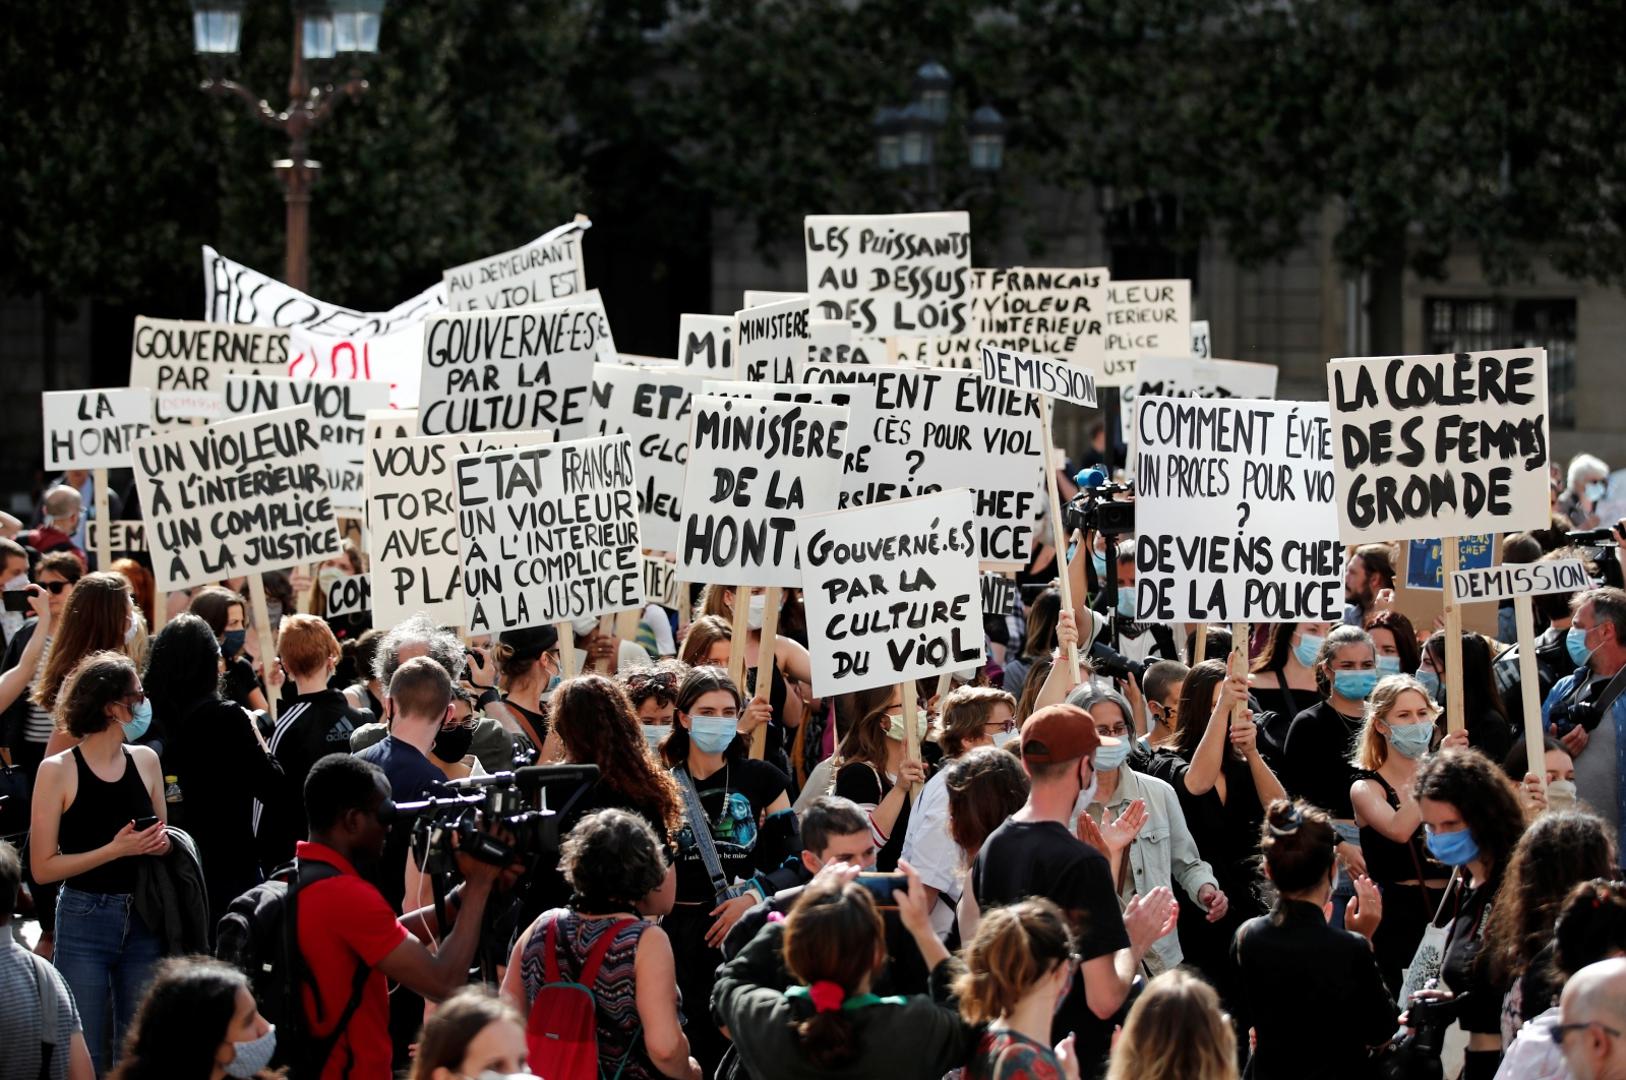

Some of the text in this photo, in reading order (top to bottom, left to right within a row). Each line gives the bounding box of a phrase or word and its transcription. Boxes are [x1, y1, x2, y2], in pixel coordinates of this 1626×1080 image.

[808, 226, 849, 258] LES
[450, 240, 575, 293] AU DEMEURANT
[818, 265, 968, 299] AU DESSUS
[486, 279, 545, 310] VIOL
[551, 270, 579, 298] EST
[1107, 286, 1174, 304] LEUR
[739, 308, 810, 346] MINISTERE
[817, 298, 876, 334] DES
[158, 366, 209, 390] PAR
[447, 361, 551, 395] PAR LA
[774, 357, 794, 384] LA
[982, 348, 1097, 401] DEMISSION
[1335, 353, 1534, 413] LA COLÈRE
[78, 392, 115, 421] LA
[226, 380, 279, 413] UN
[289, 382, 365, 420] VIOL
[422, 386, 587, 436] CULTURE
[923, 421, 972, 451] POUR
[984, 425, 1041, 456] VIOL
[1140, 400, 1274, 455] COMMENT
[1341, 415, 1425, 471] DES
[139, 440, 185, 476] UN
[373, 444, 446, 477] VOUS
[456, 440, 633, 506] ETAT FRANÇAIS
[905, 449, 925, 482] ?
[1139, 452, 1160, 498] UN
[1167, 454, 1230, 498] PROCES
[1243, 460, 1295, 502] POUR
[710, 466, 804, 510] DE LA
[1347, 467, 1512, 530] GRONDE
[157, 516, 201, 551] UN
[460, 490, 635, 538] UN VIOLEUR
[1237, 502, 1250, 536] ?
[200, 542, 236, 574] LA
[684, 513, 800, 569] HONT
[1137, 535, 1345, 576] DEVIENS CHEF
[465, 565, 502, 597] UN
[514, 546, 637, 587] COMPLICE
[822, 567, 936, 604] PAR LA
[1454, 563, 1585, 599] DEMISSION
[500, 592, 530, 627] LA
[543, 573, 640, 620] JUSTICE
[825, 594, 970, 640] CULTURE
[1137, 578, 1342, 620] DE LA POLICE
[832, 651, 869, 679] DU
